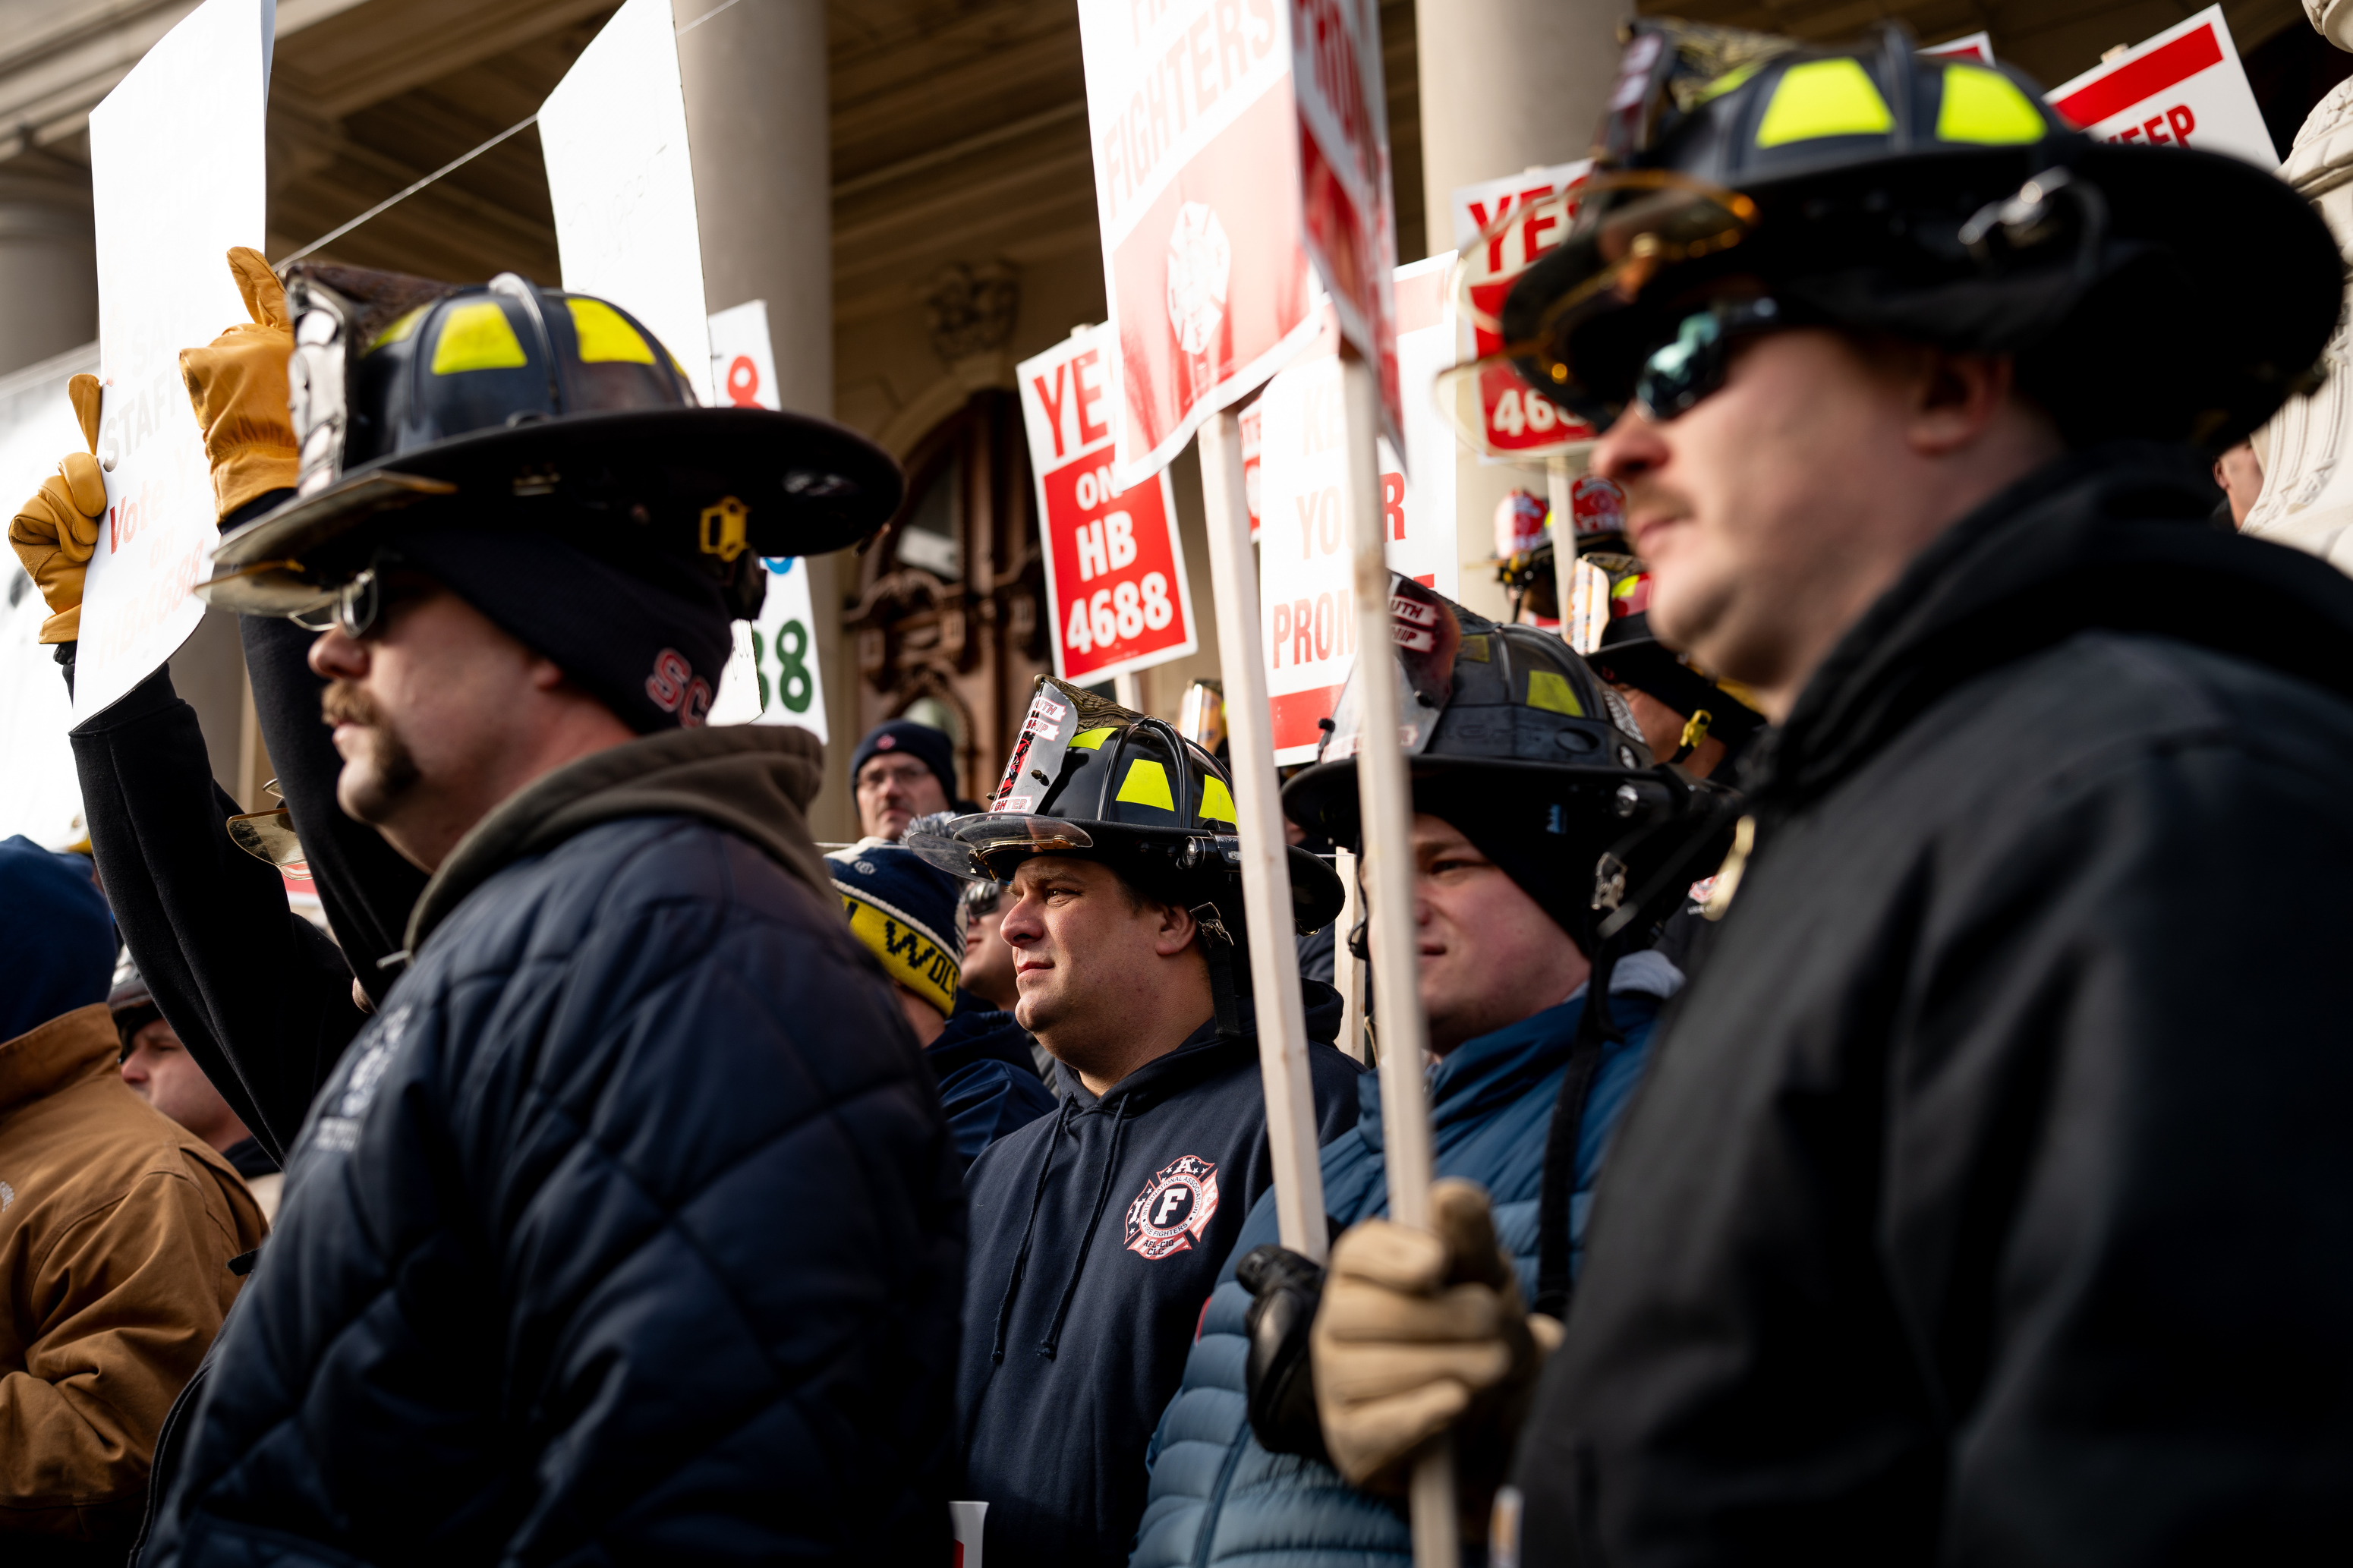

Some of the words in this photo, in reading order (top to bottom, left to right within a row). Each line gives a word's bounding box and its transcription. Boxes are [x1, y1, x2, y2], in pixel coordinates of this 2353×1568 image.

[1103, 0, 1276, 222] FIGHTERS
[1033, 348, 1109, 458] YE
[1302, 378, 1345, 457] KE
[1491, 387, 1588, 438] 46
[1075, 464, 1123, 512] ON
[110, 478, 165, 556] Vote
[1075, 509, 1137, 582] HB
[1066, 571, 1173, 655] 4688
[1390, 599, 1423, 619] UTH
[1026, 719, 1048, 732] SHIP
[1171, 1159, 1192, 1175] A
[1142, 1176, 1183, 1217] INTERNATIONAL
[1183, 1176, 1201, 1214] ASSOCIATION
[1154, 1188, 1187, 1224] F
[1142, 1223, 1152, 1235] FIRE
[1153, 1222, 1188, 1237] FIGHTERS
[1143, 1239, 1173, 1248] AFL-CIO
